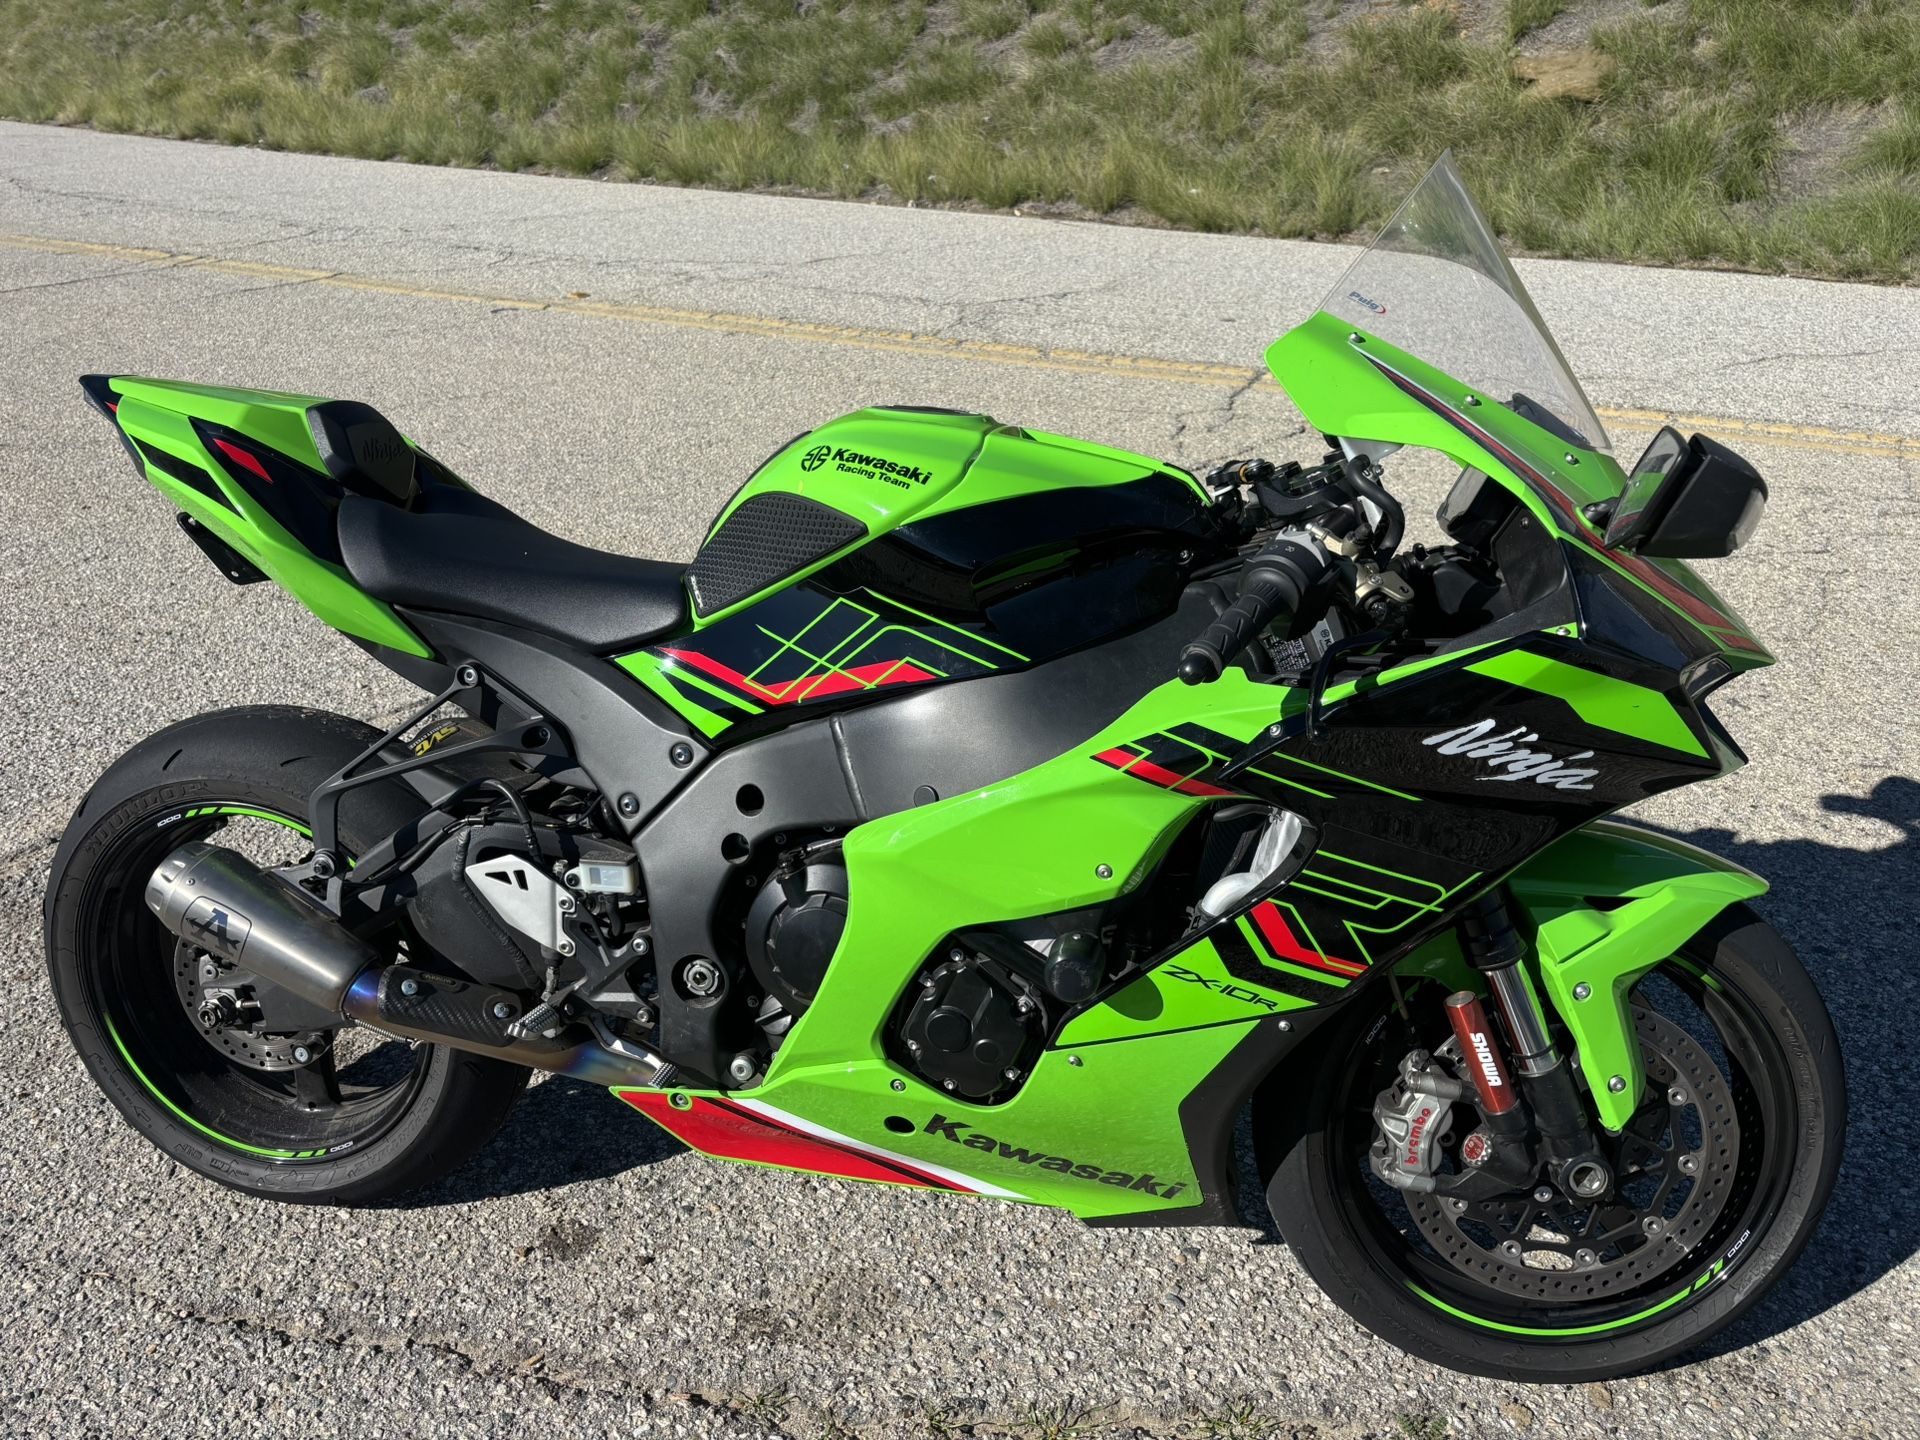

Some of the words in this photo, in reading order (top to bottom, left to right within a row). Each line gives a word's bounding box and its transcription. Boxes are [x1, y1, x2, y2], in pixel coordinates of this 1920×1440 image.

[1348, 290, 1380, 311] Puig
[831, 447, 933, 486] Kawasaki
[835, 462, 876, 480] Racing
[878, 471, 911, 490] Team
[415, 725, 458, 757] SVC
[1421, 718, 1599, 790] Ninja
[156, 813, 182, 828] 1000
[1160, 964, 1279, 1011] ZX-10R
[1469, 1032, 1503, 1087] SHOWA
[1404, 1107, 1431, 1166] brembo
[923, 1113, 1187, 1200] Kawasaki
[1727, 1229, 1751, 1258] 1000
